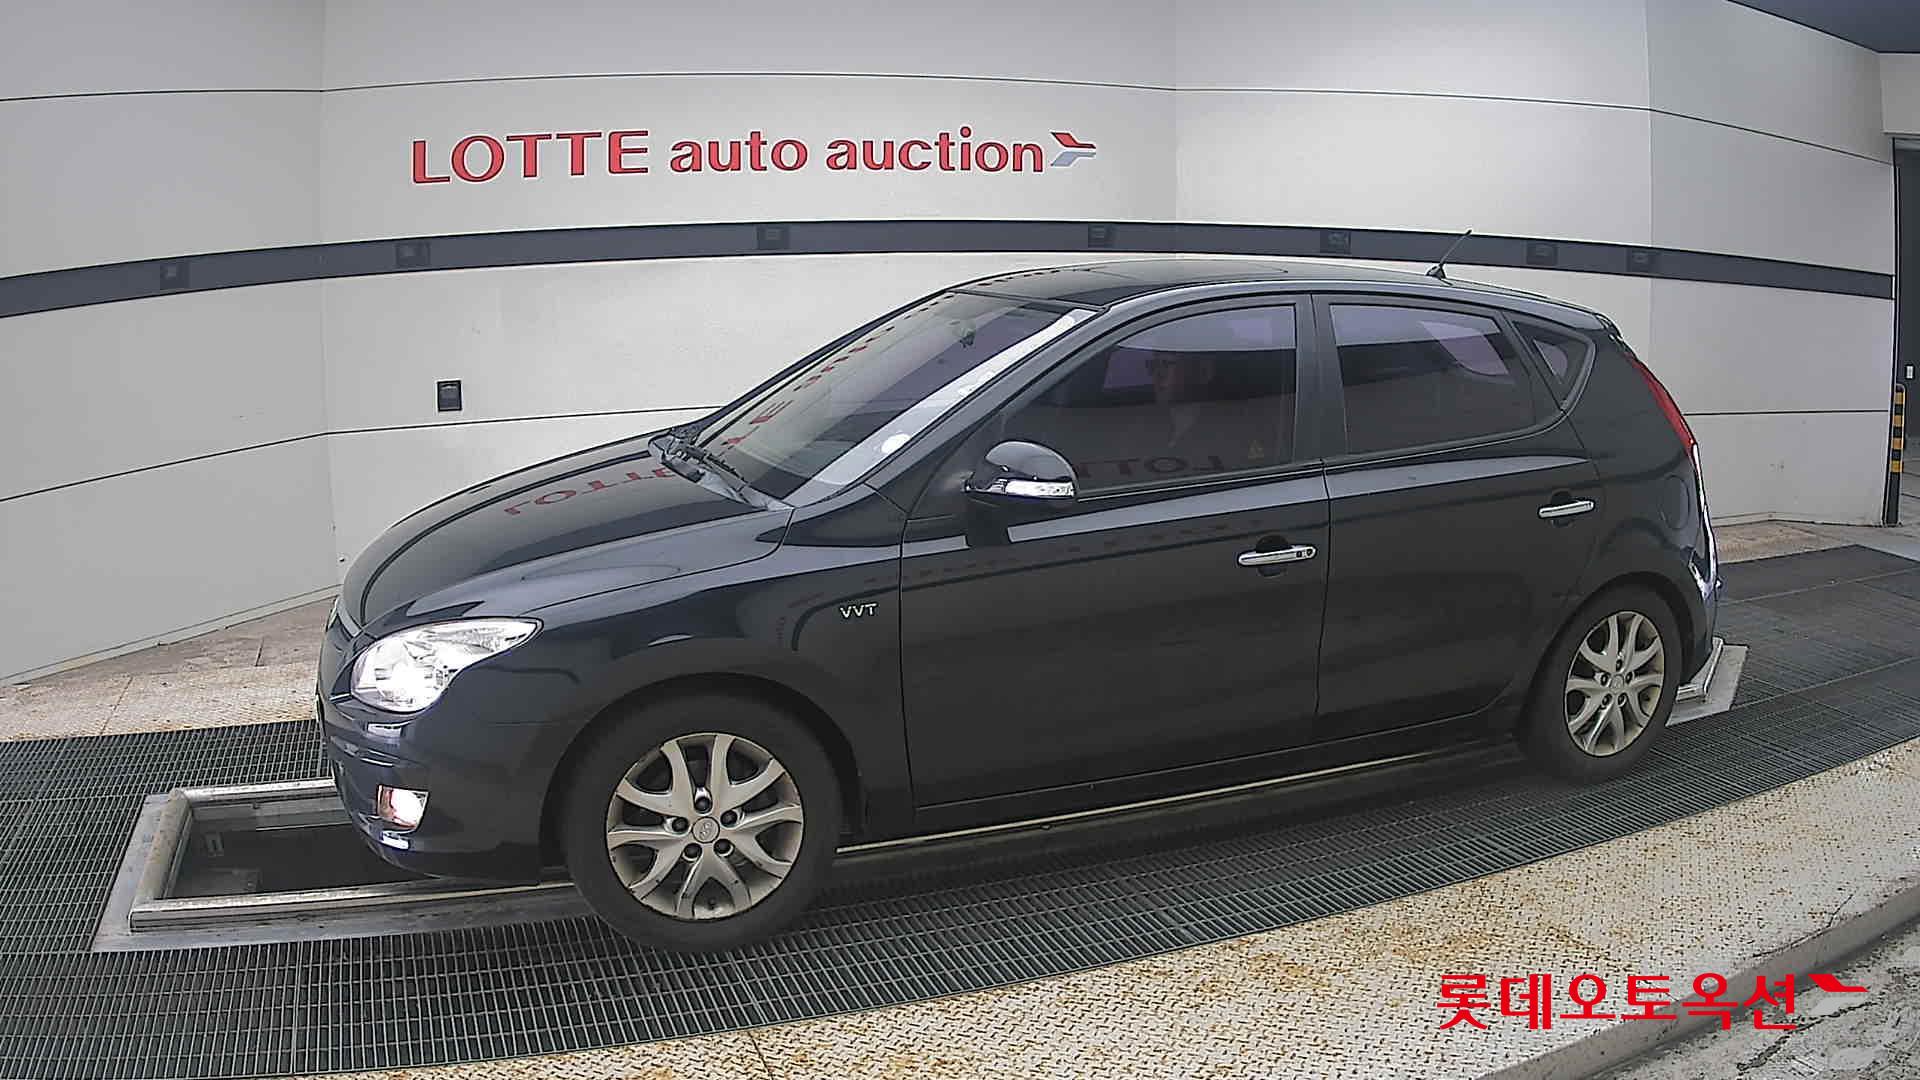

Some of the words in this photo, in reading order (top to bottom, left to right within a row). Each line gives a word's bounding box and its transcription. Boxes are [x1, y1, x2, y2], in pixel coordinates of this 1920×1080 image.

[412, 130, 649, 184] LOTTE
[670, 131, 809, 173] auto
[825, 126, 1044, 173] auction
[840, 603, 877, 618] VVT
